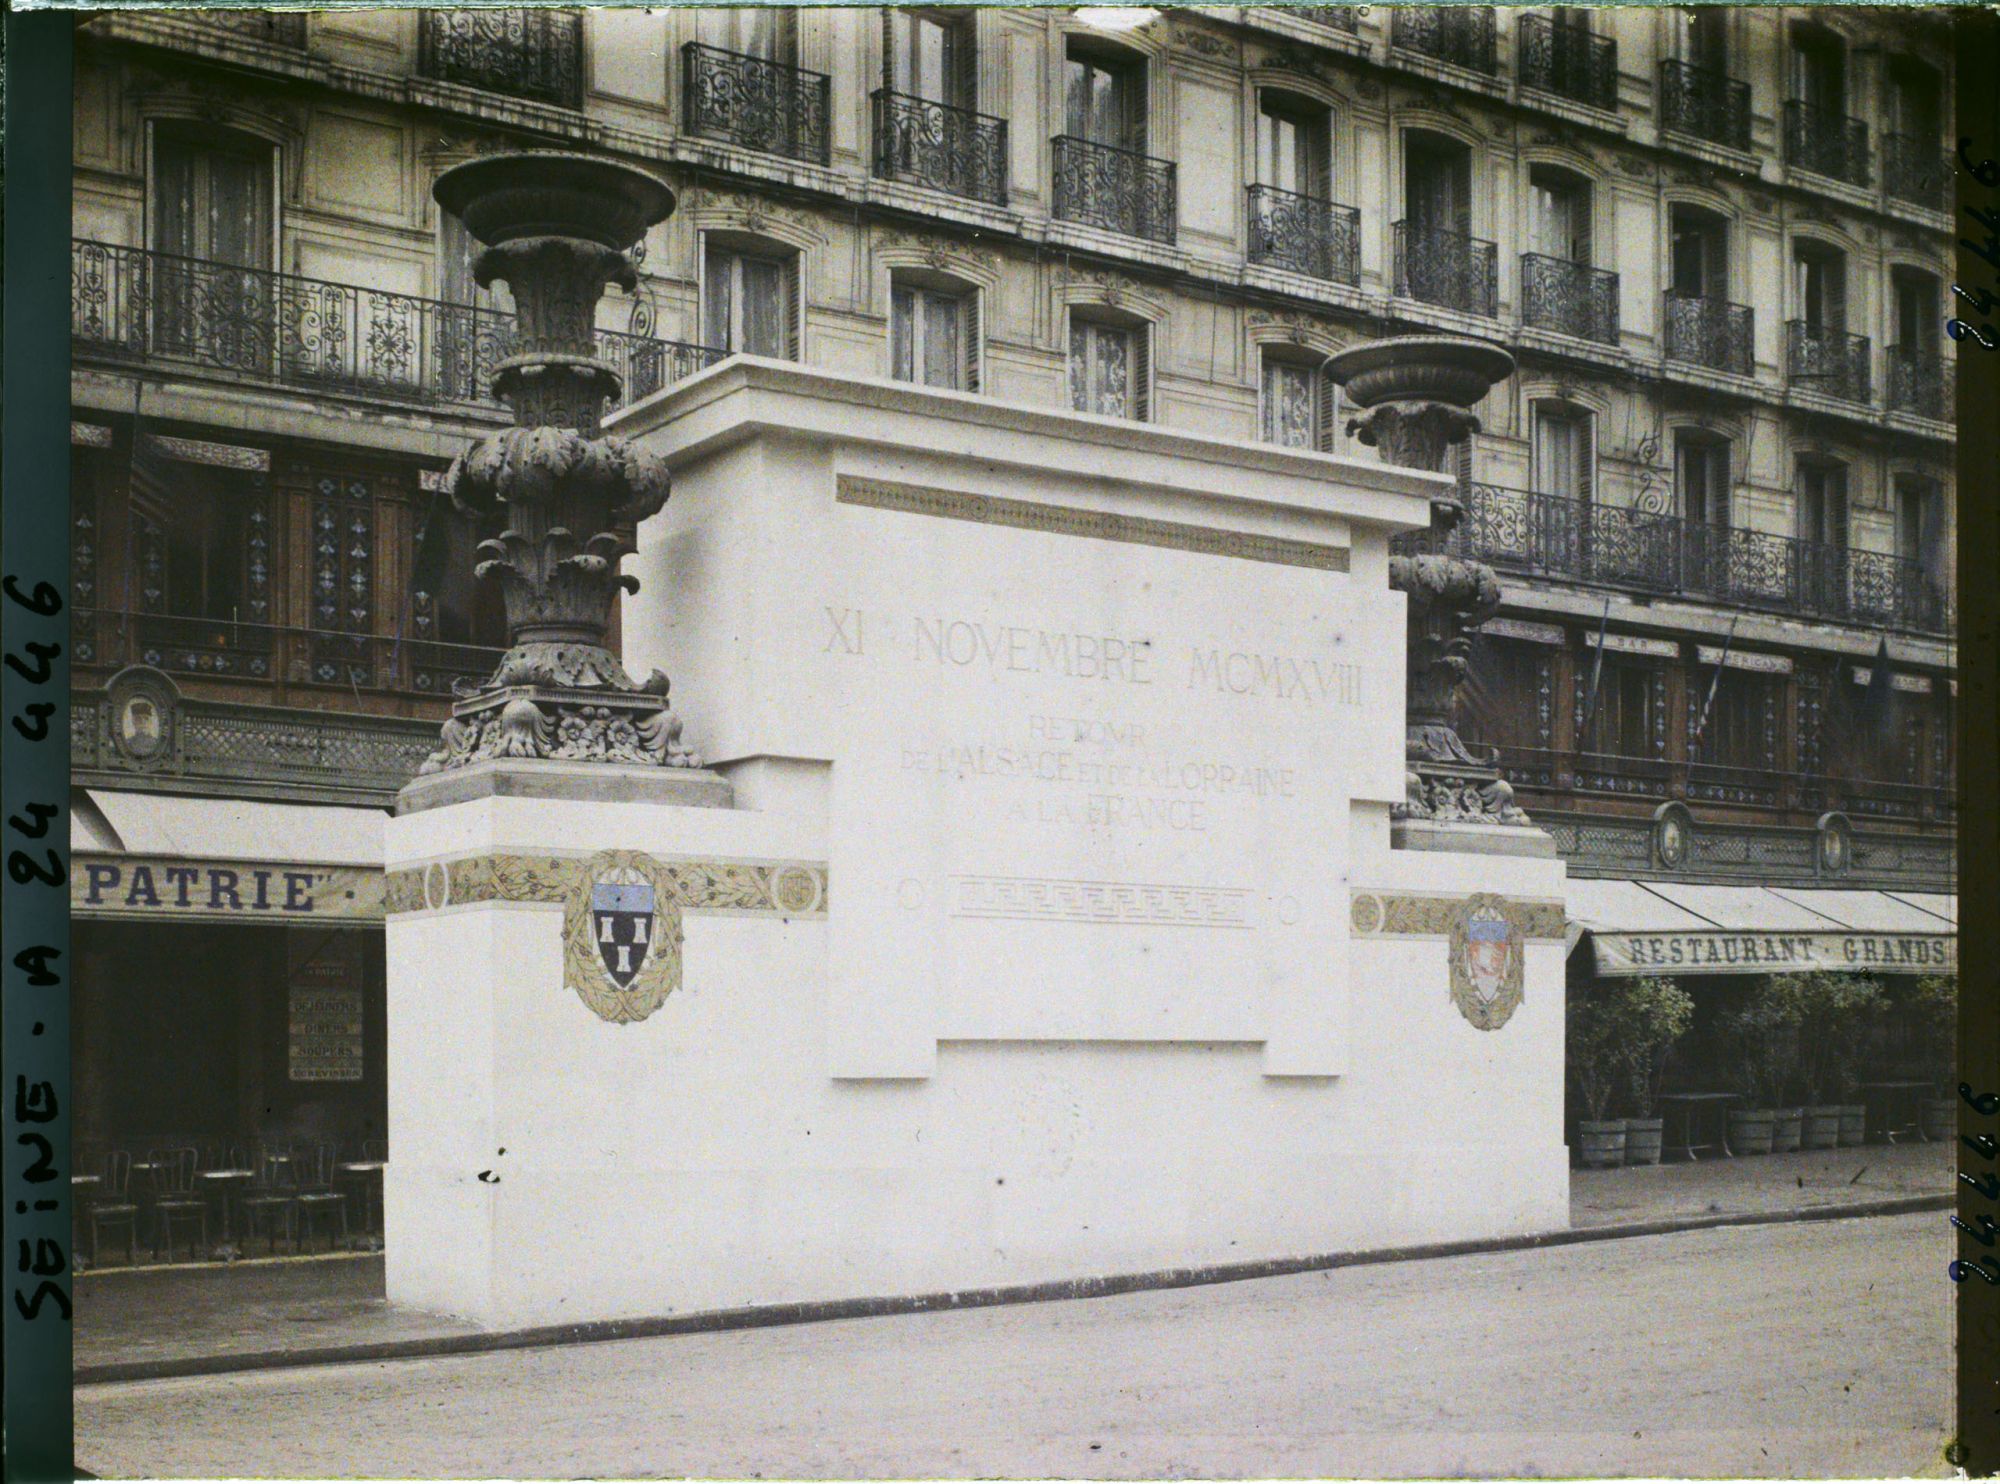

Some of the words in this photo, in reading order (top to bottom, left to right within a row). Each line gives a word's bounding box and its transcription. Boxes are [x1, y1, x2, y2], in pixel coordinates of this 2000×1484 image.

[822, 605, 866, 656] XI
[913, 616, 1155, 686] NOVEMBRE
[1186, 645, 1365, 708] MCMXVIII
[1617, 637, 1647, 651] BAR
[900, 748, 929, 771] DE
[1087, 793, 1207, 833] FRANCE
[1628, 936, 1815, 966] RESTAURANT
[1843, 937, 1947, 966] GRANDS
